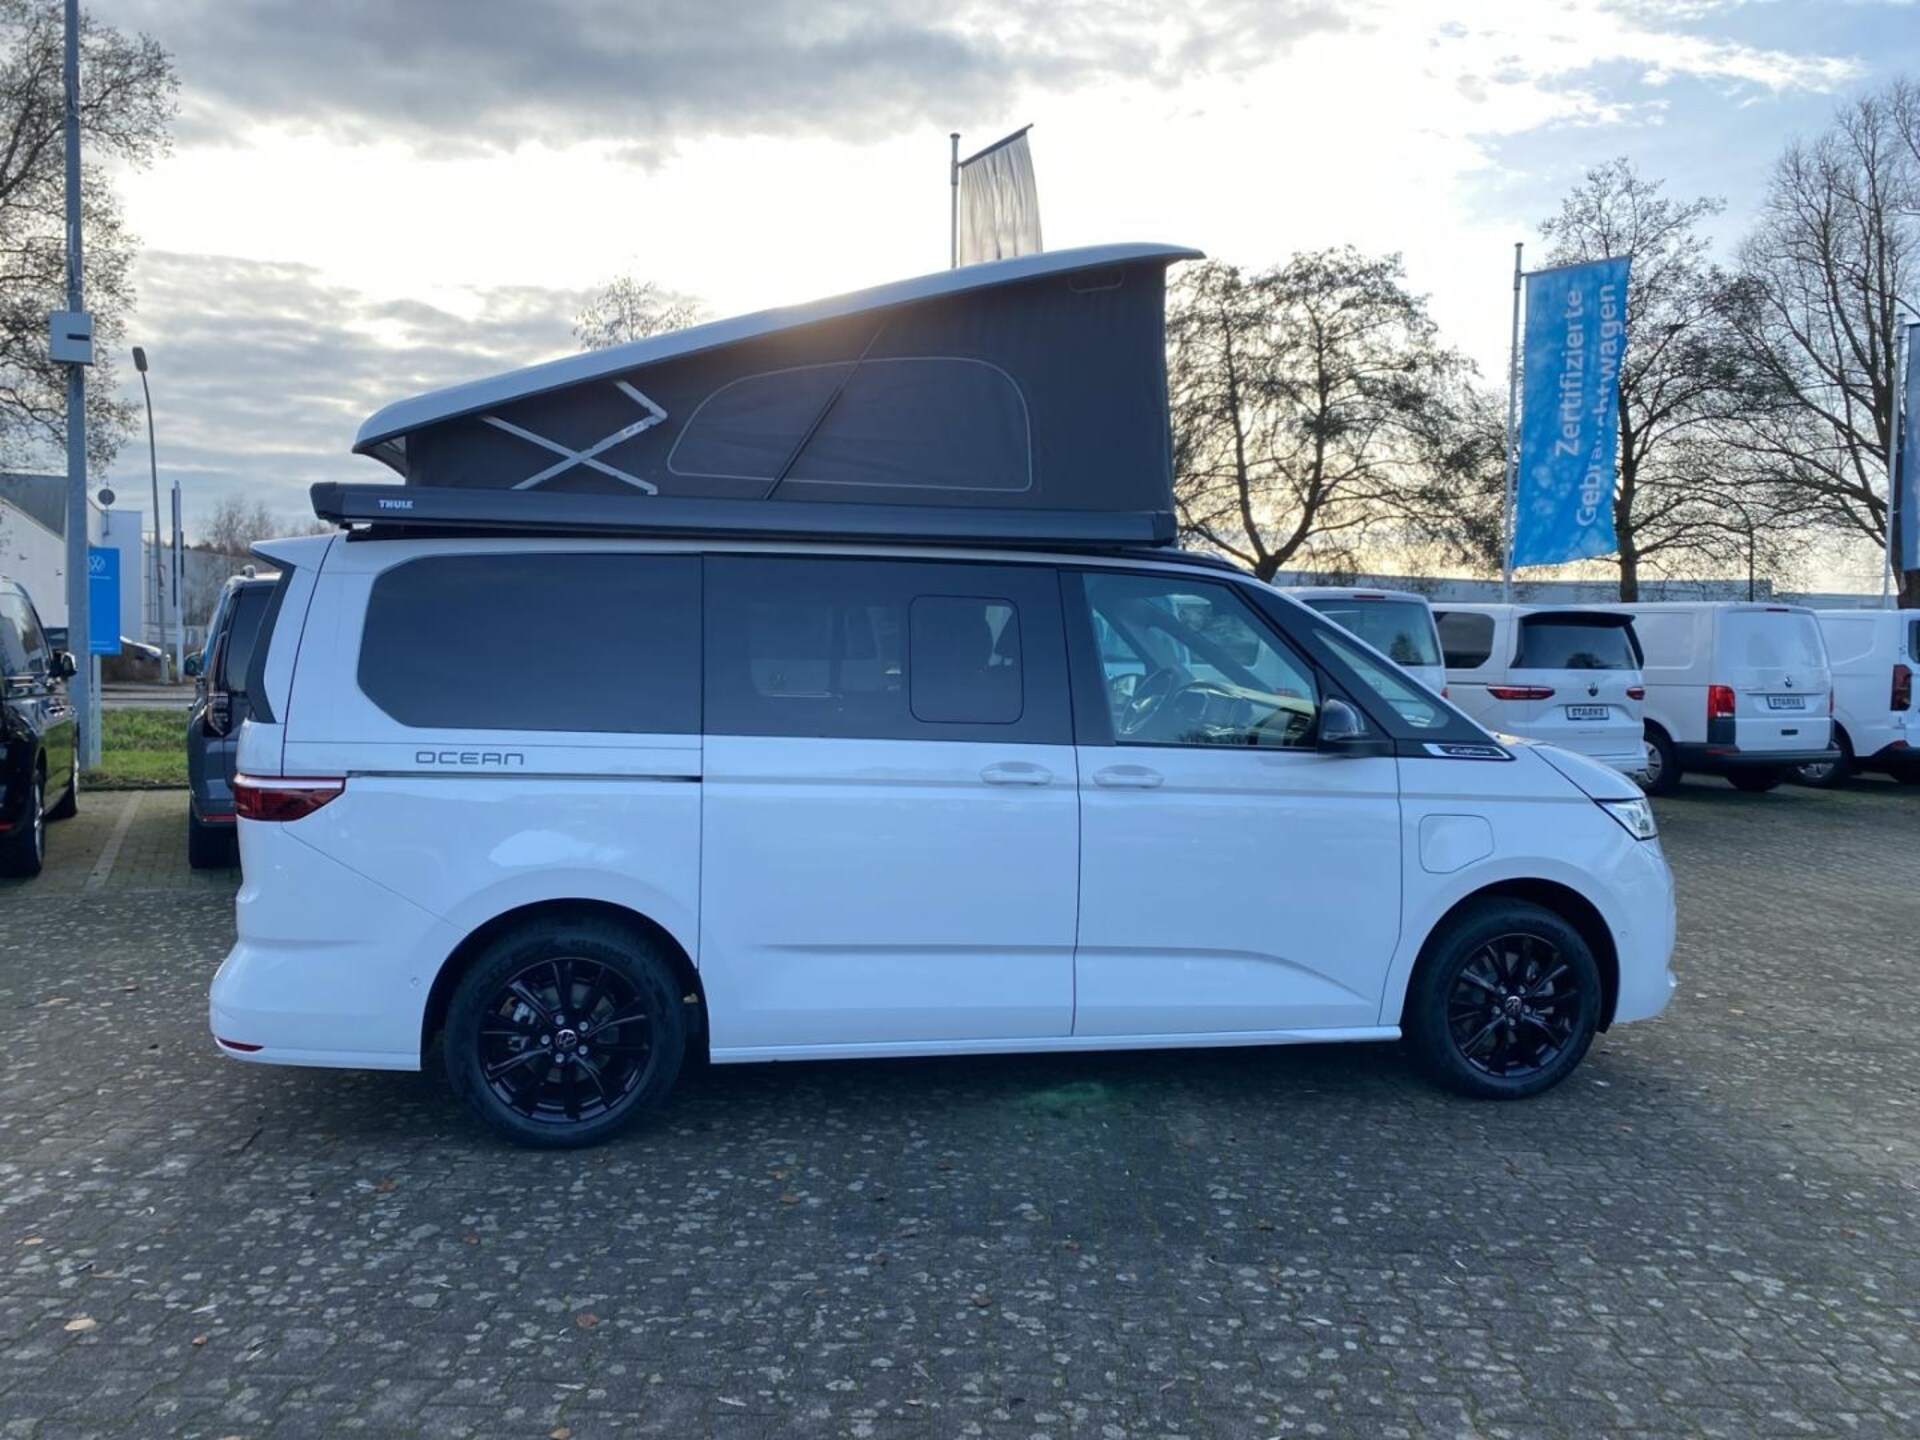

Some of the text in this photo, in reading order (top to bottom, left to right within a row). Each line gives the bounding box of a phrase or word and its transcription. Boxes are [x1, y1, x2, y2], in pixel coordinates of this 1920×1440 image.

[1556, 289, 1584, 456] Zertifizierte
[1576, 284, 1623, 526] Gebrahtwagen
[379, 499, 414, 509] THULE
[416, 751, 524, 765] OCEAN
